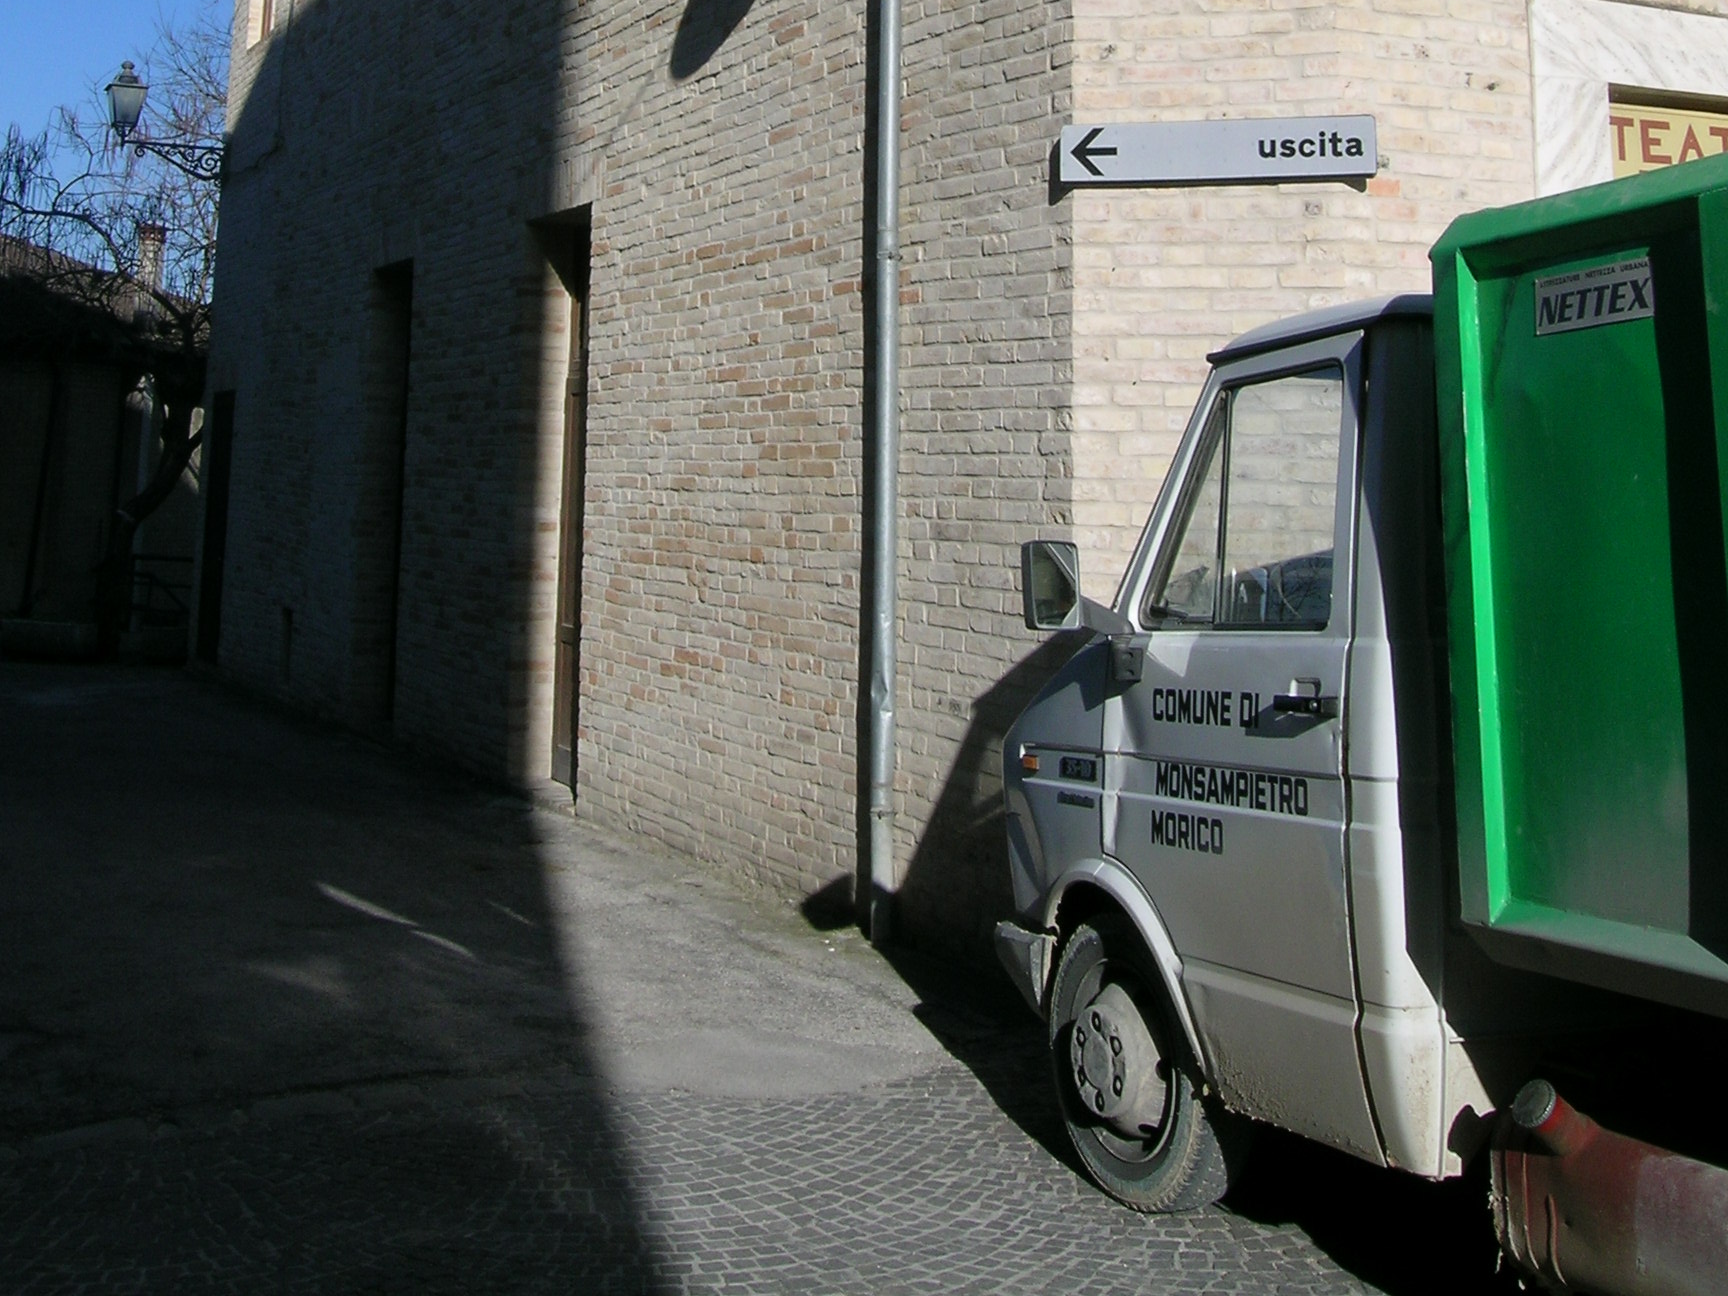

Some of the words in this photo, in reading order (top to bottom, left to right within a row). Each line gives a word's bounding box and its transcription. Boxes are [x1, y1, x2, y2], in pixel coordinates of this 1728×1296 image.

[1258, 131, 1364, 158] uscita
[1620, 261, 1649, 272] URBANA
[1539, 277, 1651, 327] NETTEX
[1152, 688, 1232, 726] COMUNE
[1239, 692, 1260, 728] DI
[1155, 762, 1309, 816] MONSAMPIETRO
[1151, 810, 1223, 854] MORICO
